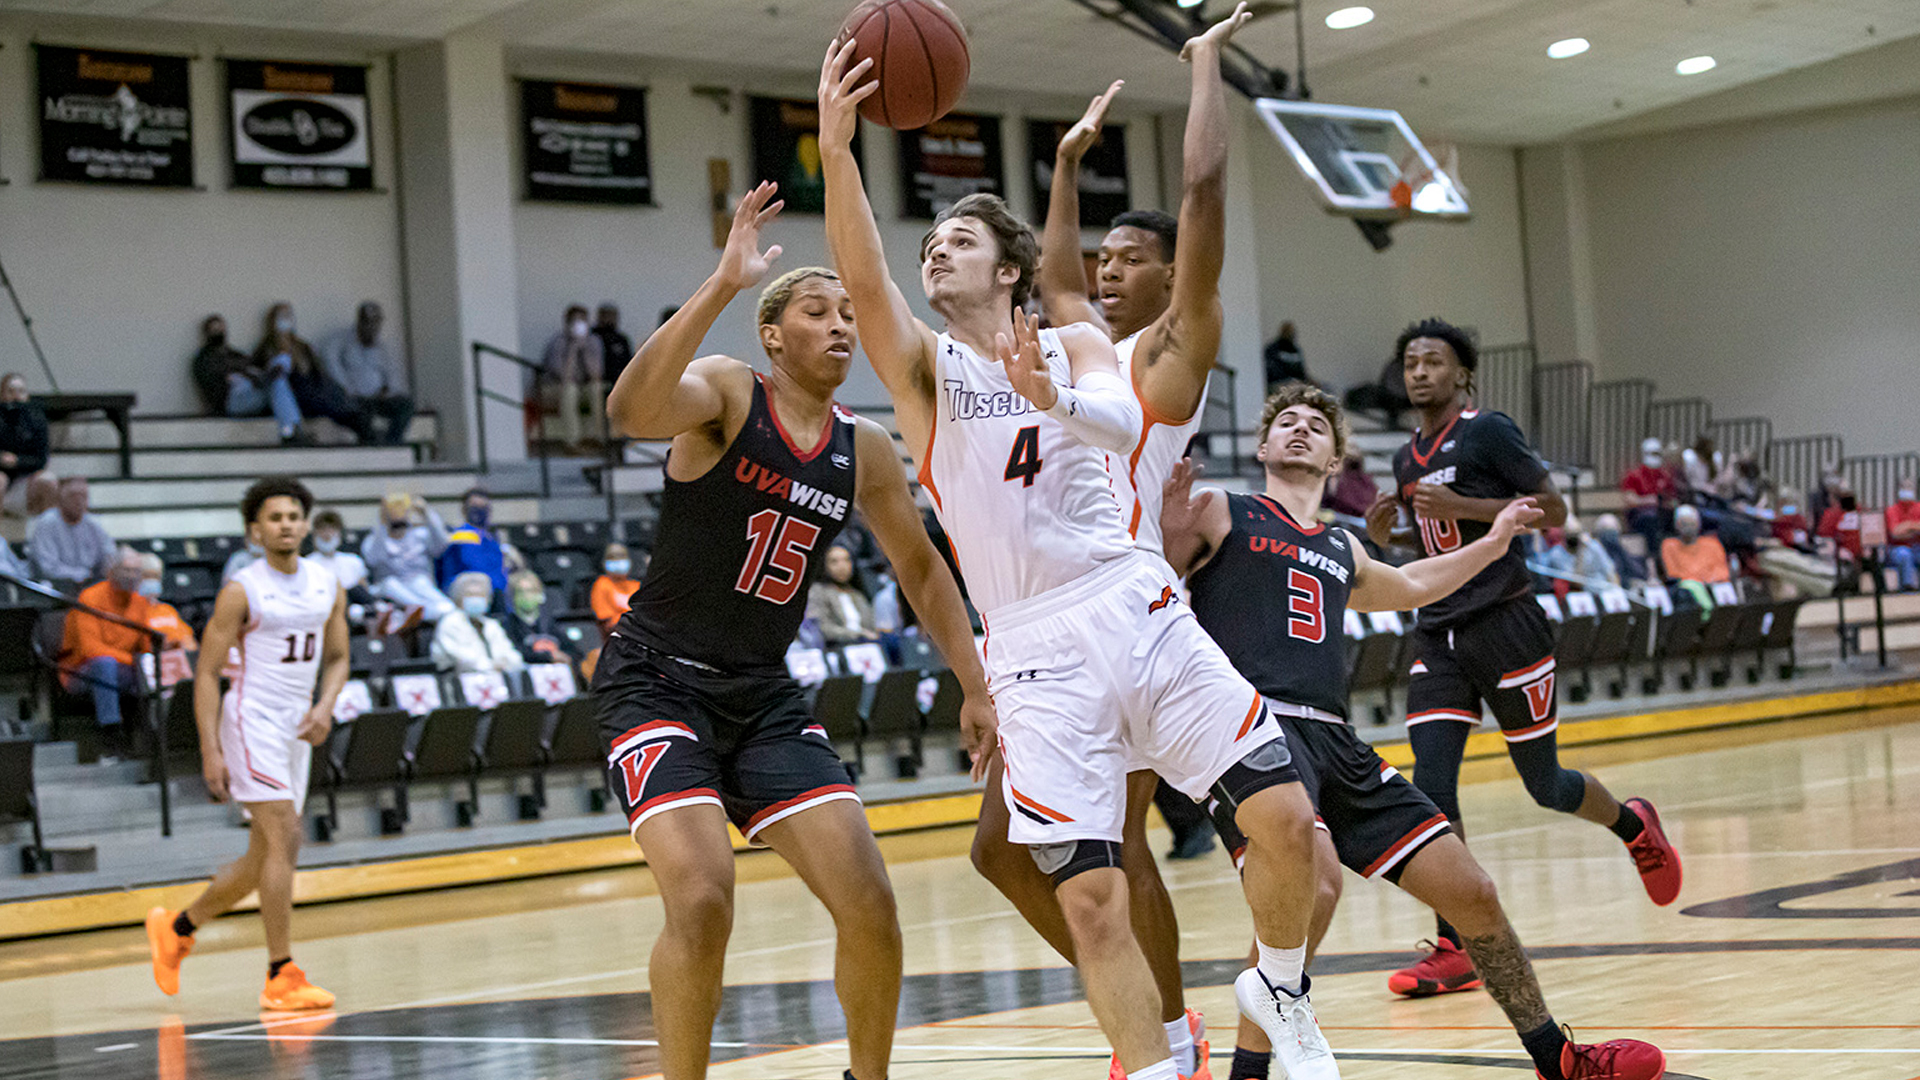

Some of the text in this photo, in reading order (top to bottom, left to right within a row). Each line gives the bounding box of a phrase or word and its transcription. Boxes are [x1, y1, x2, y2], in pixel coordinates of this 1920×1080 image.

[1003, 424, 1043, 488] 4
[734, 508, 822, 605] 15
[1287, 567, 1326, 644] 3
[281, 632, 316, 663] 10
[1521, 671, 1555, 722] V
[618, 740, 672, 807] V
